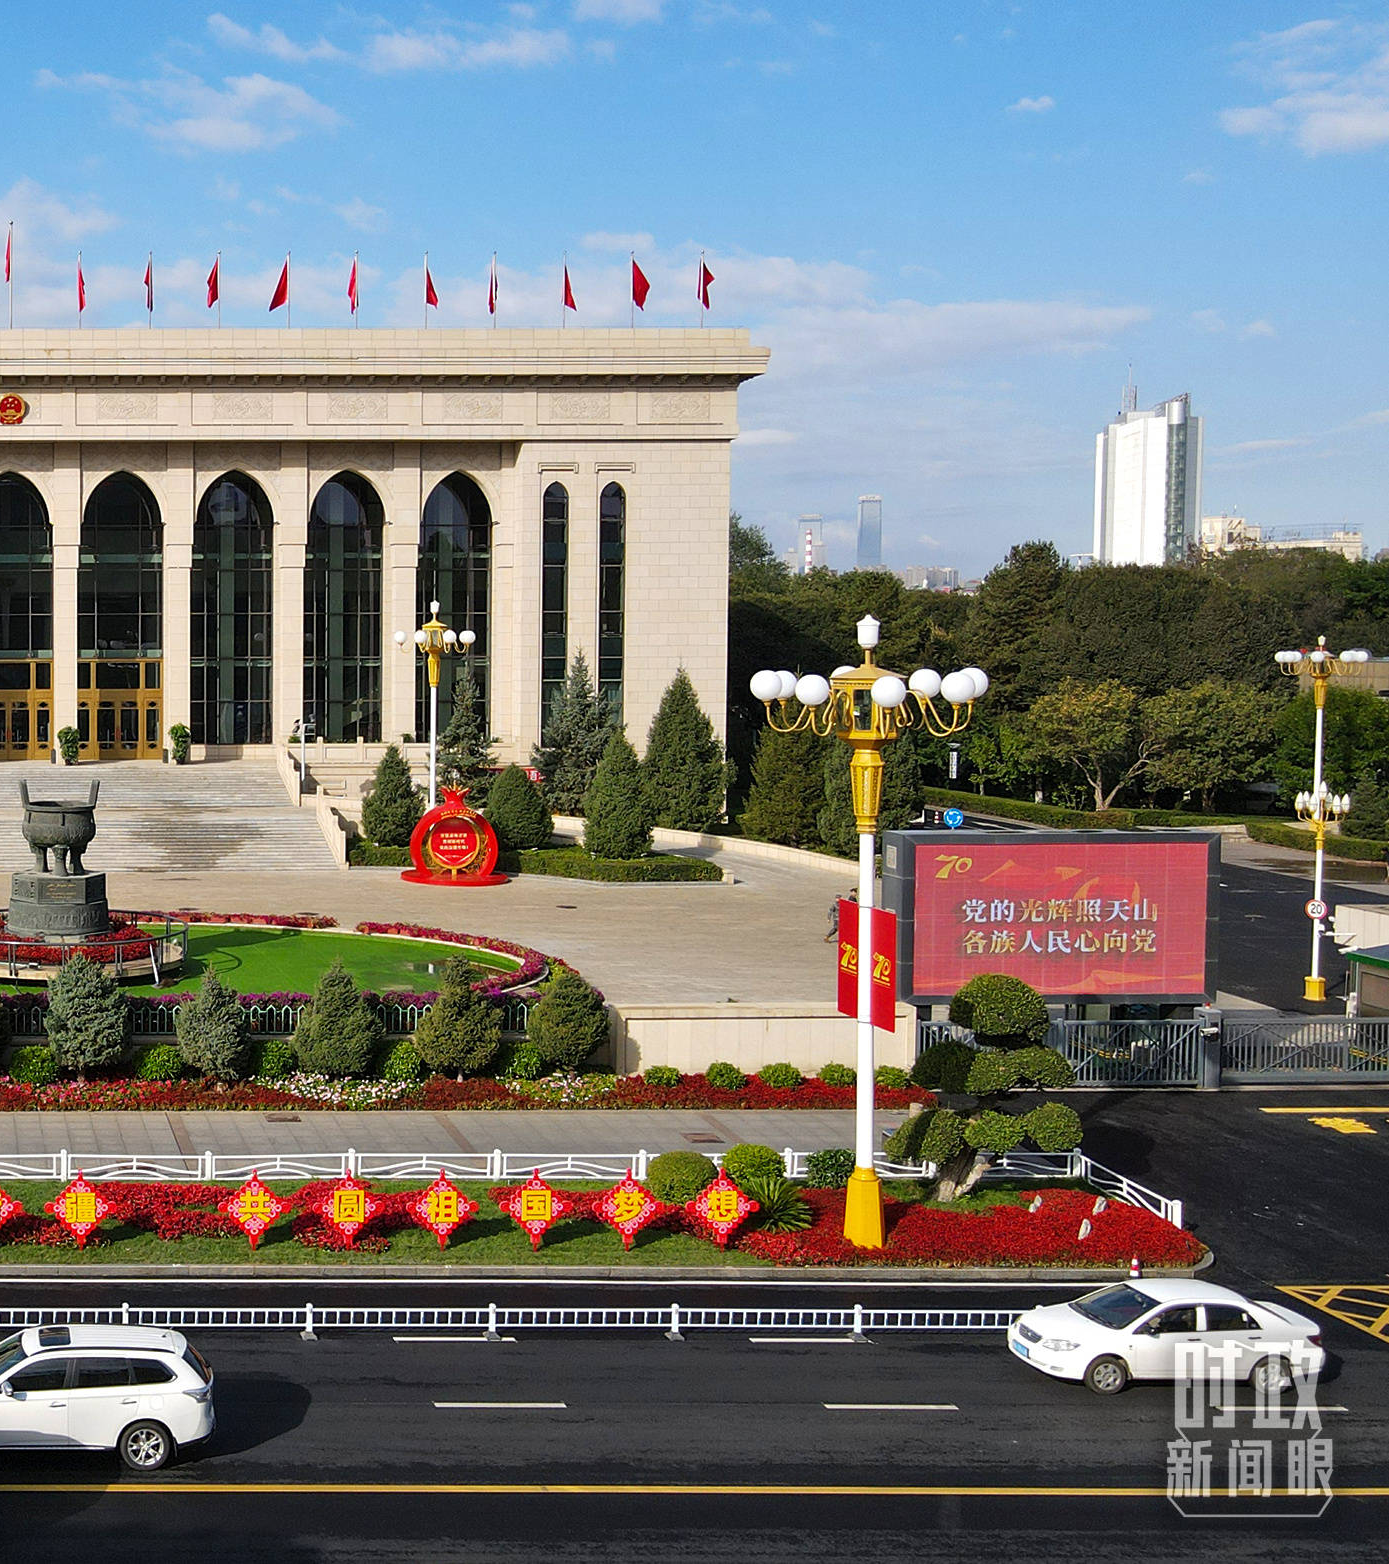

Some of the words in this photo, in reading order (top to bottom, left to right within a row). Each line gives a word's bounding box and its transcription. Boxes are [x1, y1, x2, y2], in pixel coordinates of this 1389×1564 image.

[934, 854, 973, 879] 70
[962, 898, 1158, 923] 党的光辉照天山
[963, 929, 1157, 954] 各族人民心向党
[873, 951, 892, 978] 70
[240, 1191, 738, 1222] 共圆祖国梦想
